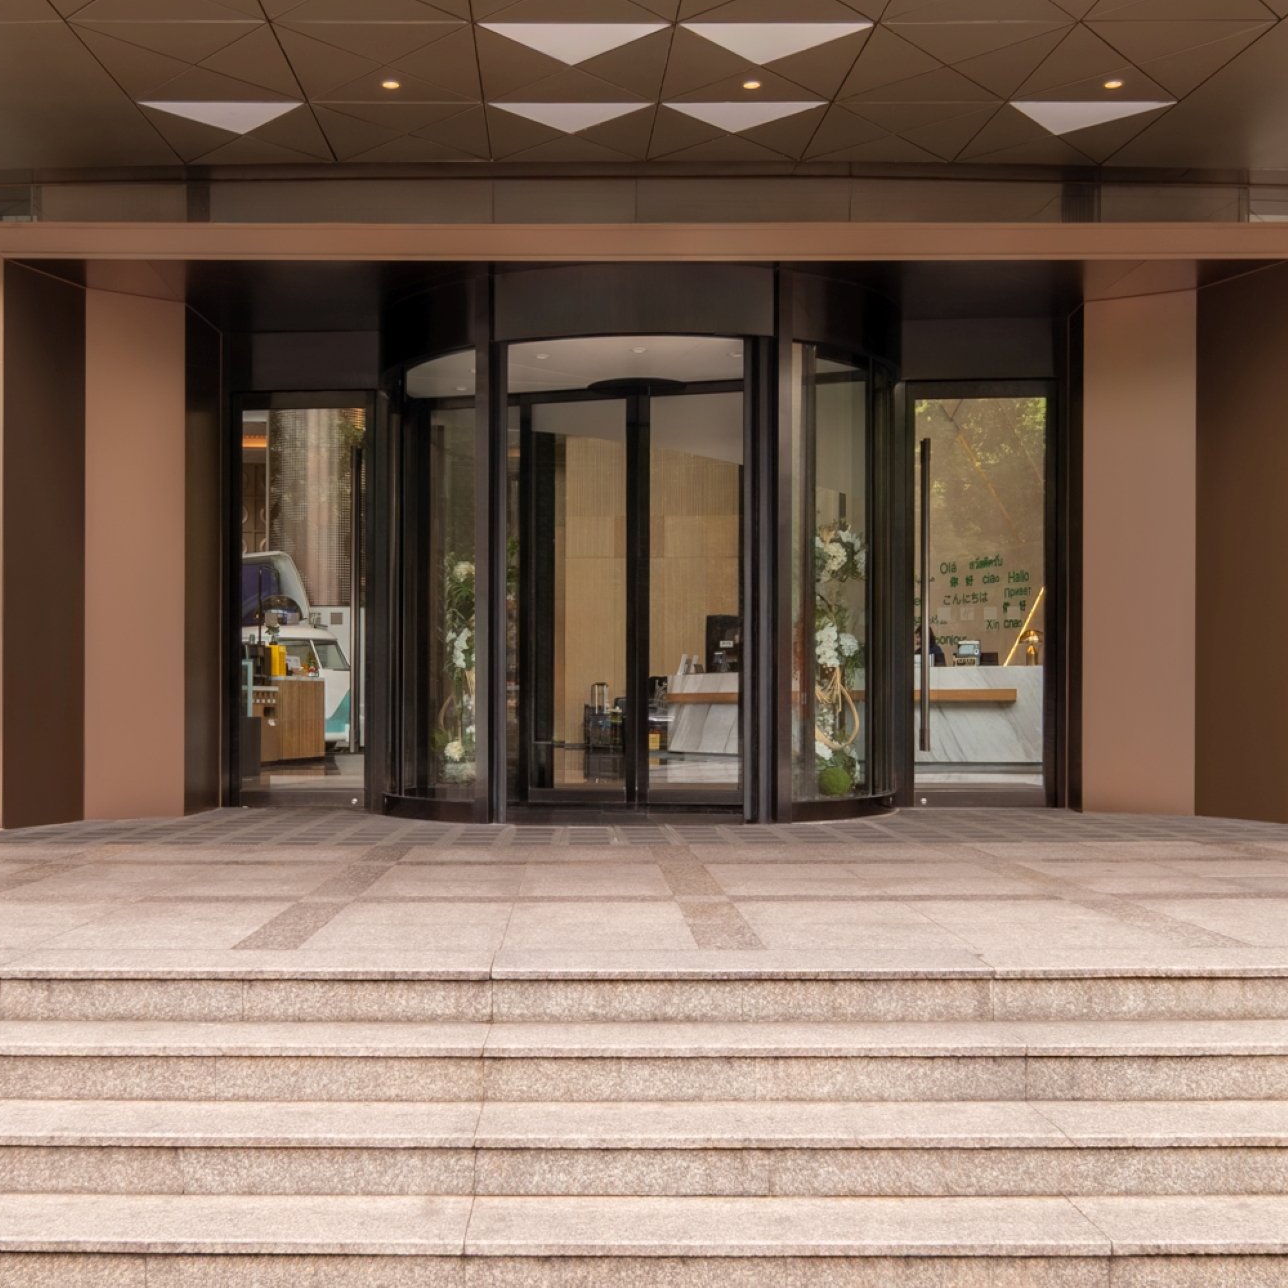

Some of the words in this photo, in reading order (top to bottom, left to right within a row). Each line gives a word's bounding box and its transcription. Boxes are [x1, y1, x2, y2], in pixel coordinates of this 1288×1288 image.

[943, 591, 989, 606] こんにちは
